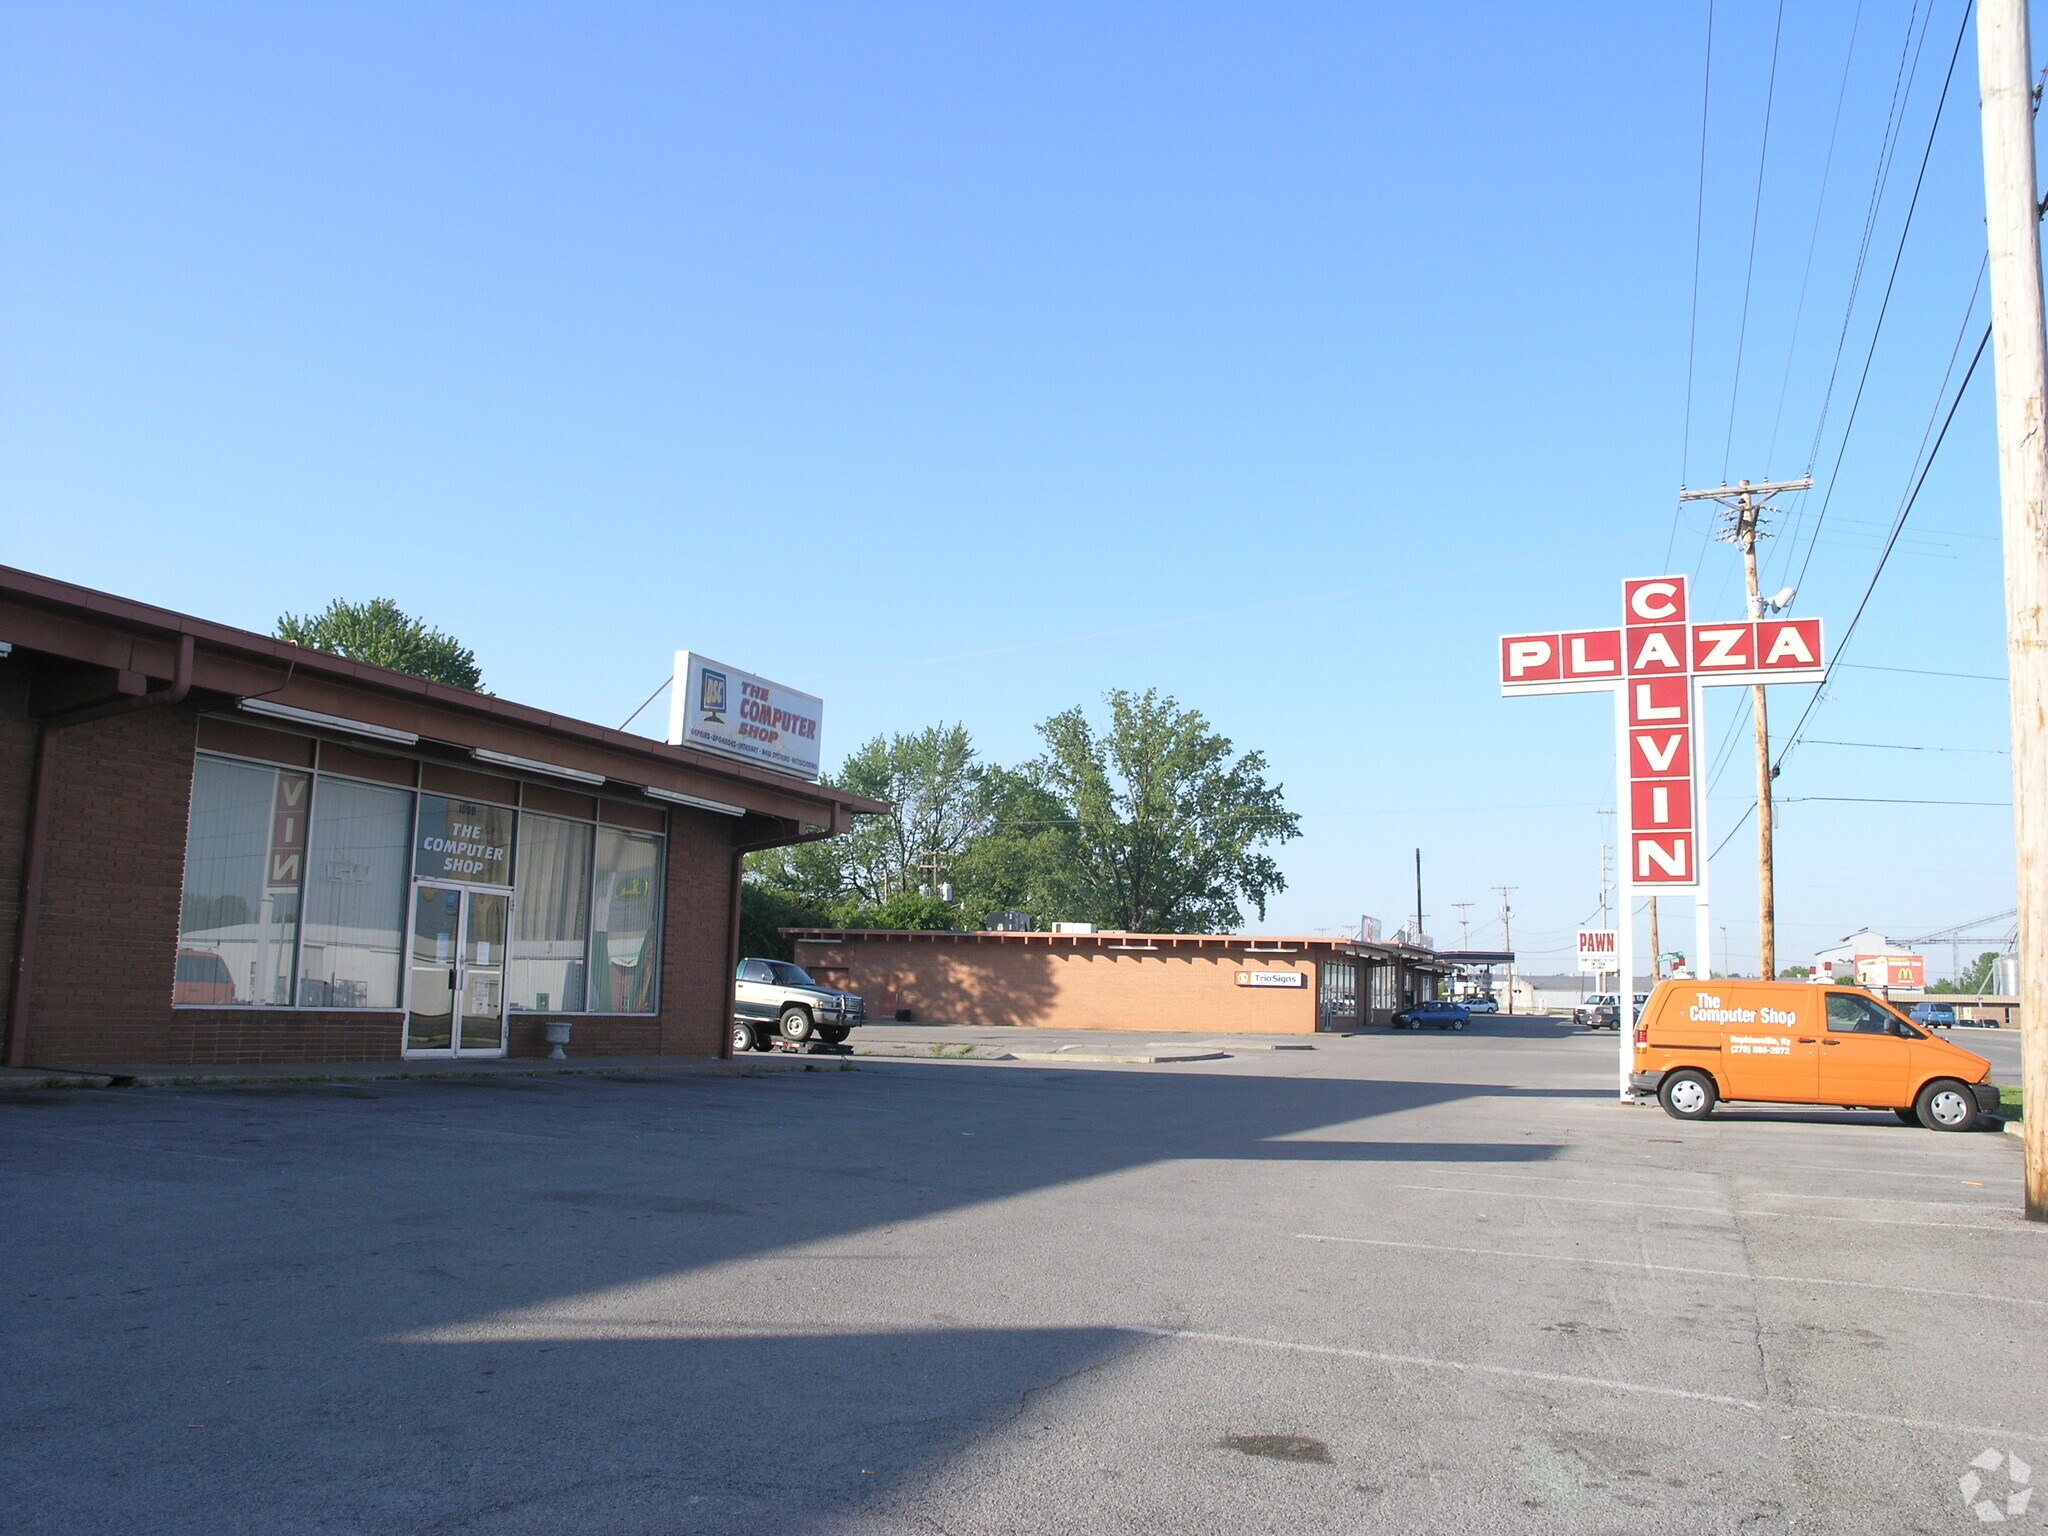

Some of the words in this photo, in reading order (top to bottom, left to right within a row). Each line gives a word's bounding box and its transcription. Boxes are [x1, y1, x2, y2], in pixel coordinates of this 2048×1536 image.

[1508, 625, 1814, 677] PLAZA
[741, 681, 769, 702] THE
[740, 698, 816, 740] COMPUTER
[1631, 582, 1686, 877] CALVIN
[738, 722, 779, 744] SHOP
[452, 823, 481, 839] THE
[423, 836, 504, 861] COMPUTER
[443, 858, 484, 874] SHOP
[1580, 933, 1614, 952] PAWN
[1255, 974, 1272, 982] Trio
[1272, 974, 1296, 983] Signs
[1696, 993, 1721, 1008] The
[1689, 1005, 1757, 1026] Computer
[1760, 1007, 1796, 1028] Shop
[1730, 1045, 1752, 1055] (270)
